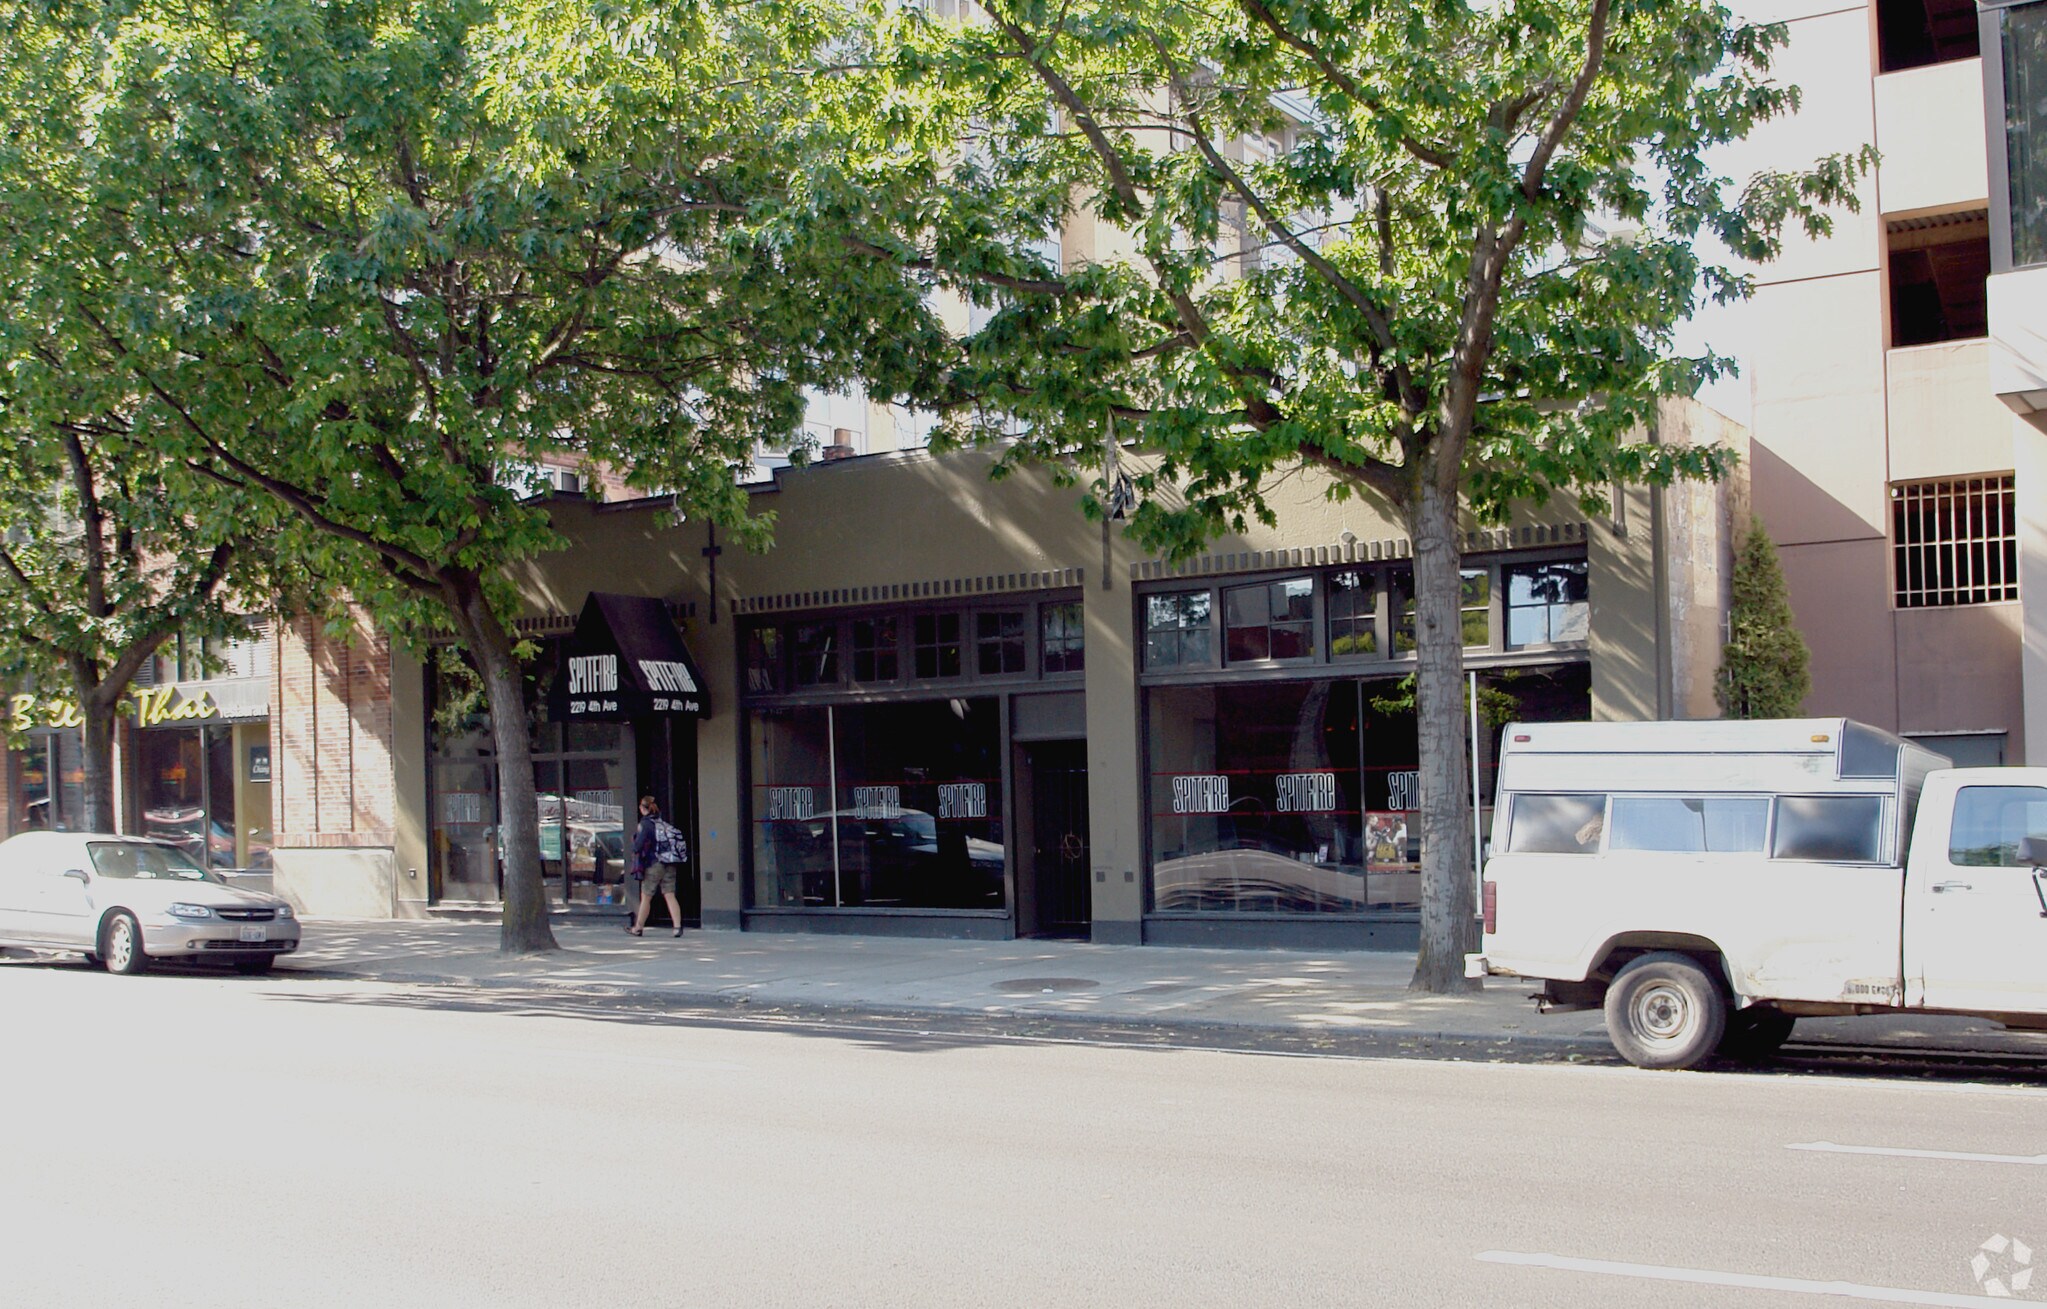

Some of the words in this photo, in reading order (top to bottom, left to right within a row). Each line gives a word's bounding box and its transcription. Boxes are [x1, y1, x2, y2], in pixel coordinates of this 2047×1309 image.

[133, 685, 218, 728] Thai
[570, 701, 587, 714] 2219
[588, 700, 601, 712] 4th
[602, 700, 618, 712] Ave
[653, 698, 669, 711] 2219
[670, 698, 684, 712] 4th
[684, 699, 700, 712] Ave
